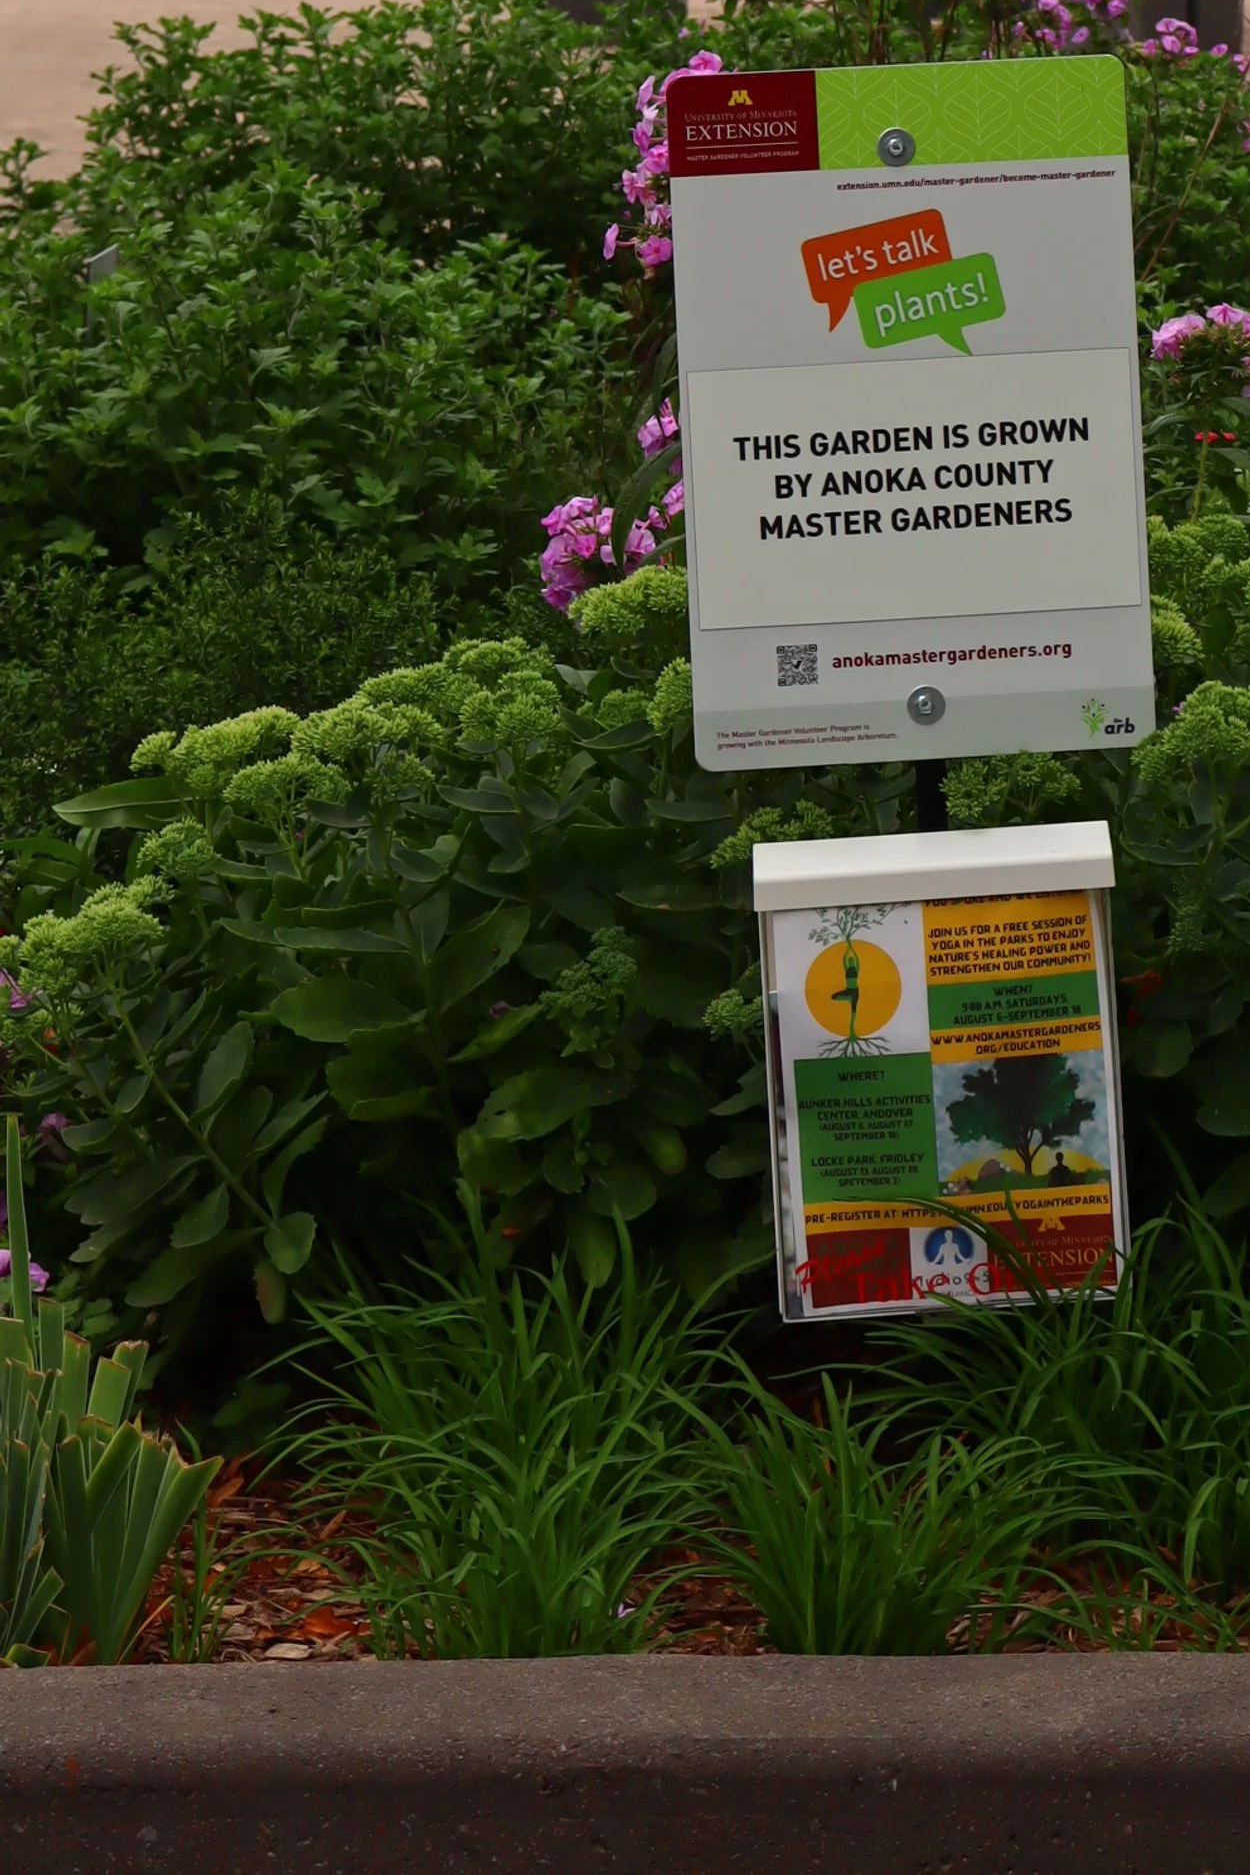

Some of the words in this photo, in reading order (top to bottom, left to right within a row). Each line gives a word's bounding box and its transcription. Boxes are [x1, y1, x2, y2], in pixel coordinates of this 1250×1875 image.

[686, 120, 797, 141] EXTENSION
[837, 169, 1116, 191] extension.umn.edu/master-gardener/become-master-gardener
[817, 246, 878, 281] let's
[882, 228, 939, 265] talk
[875, 272, 988, 338] plants!
[733, 433, 801, 461] THIS
[810, 426, 933, 457] GARDEN
[943, 424, 969, 449] IS
[978, 417, 1089, 447] GROWN
[775, 473, 813, 499] BY
[821, 467, 926, 497] ANOKA
[934, 459, 1054, 489] COUNTY
[759, 510, 882, 540] MASTER
[891, 498, 1072, 532] GARDENERS
[832, 643, 1072, 669] anokamastergardeners.org
[732, 730, 757, 738] Master
[759, 728, 792, 737] Gardener
[794, 726, 828, 735] Volunteer
[830, 724, 862, 734] Program
[1104, 717, 1136, 735] arb
[717, 741, 746, 751] growing
[748, 740, 763, 748] with
[778, 736, 815, 746] Minnesota
[817, 734, 856, 744] Landscape
[928, 927, 953, 939] JOIN
[954, 926, 968, 936] US
[970, 924, 991, 935] FOR
[993, 923, 1001, 933] A
[1003, 921, 1028, 932] FREE
[1031, 916, 1072, 930] SESSION
[1074, 914, 1088, 925] OF
[931, 939, 961, 950] YOGA
[963, 937, 974, 948] IN
[977, 936, 997, 947] THE
[1000, 933, 1035, 945] PARKS
[1037, 931, 1050, 942] TO
[1052, 928, 1086, 940] ENJOY
[929, 950, 979, 964] NATURE'S
[982, 947, 1027, 960] HEALING
[1029, 943, 1067, 955] POWER
[1069, 940, 1090, 951] AND
[930, 962, 1001, 977] STRENGTHEN
[1003, 960, 1024, 971] OUR
[1027, 953, 1092, 969] COMMUNITY!
[993, 984, 1033, 996] WHEN?
[953, 1012, 993, 1025] AUGUST
[975, 1038, 1061, 1055] ORG/EDUCATION
[838, 1070, 885, 1082] WHERE?
[798, 1098, 840, 1110] BUNKER
[843, 1096, 873, 1108] HILLS
[875, 1094, 931, 1106] ACTIVITIES
[863, 1108, 913, 1119] ANDOVER
[867, 1120, 902, 1130] AUGUST
[834, 1131, 885, 1142] SEPTEMBER
[811, 1156, 844, 1167] LOCKE
[880, 1153, 924, 1164] FRIDLEY
[872, 1165, 905, 1175] AUGUST
[805, 1210, 881, 1225] PRE-REGISTER
[884, 1208, 897, 1219] AT
